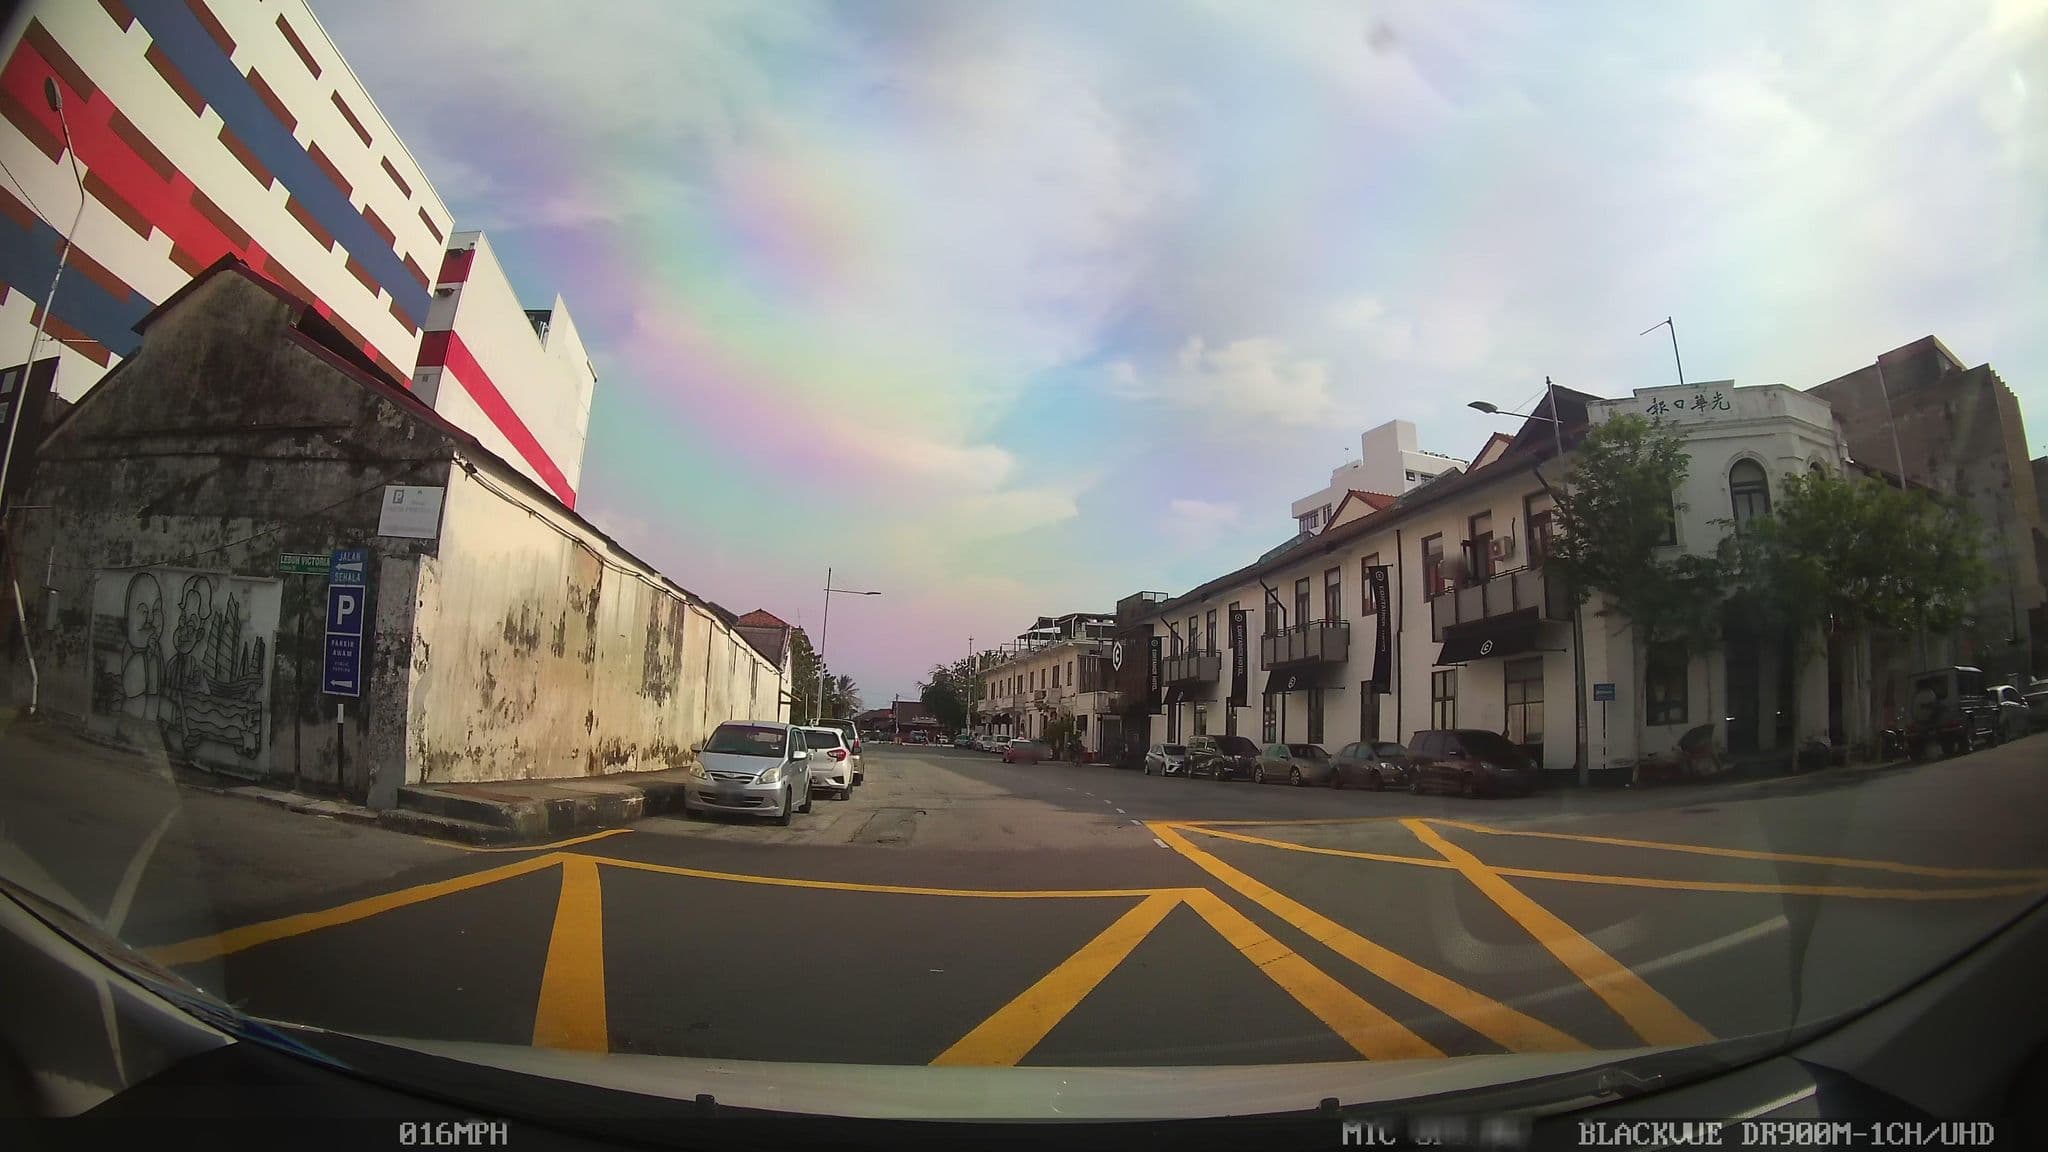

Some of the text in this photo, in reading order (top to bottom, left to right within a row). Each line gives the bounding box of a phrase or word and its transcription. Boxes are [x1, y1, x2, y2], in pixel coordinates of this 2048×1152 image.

[280, 555, 330, 567] LEBUH VICTORIA
[339, 551, 361, 561] JALAN
[334, 572, 361, 582] SEHALA
[337, 594, 355, 625] P
[332, 649, 352, 657] AWAM
